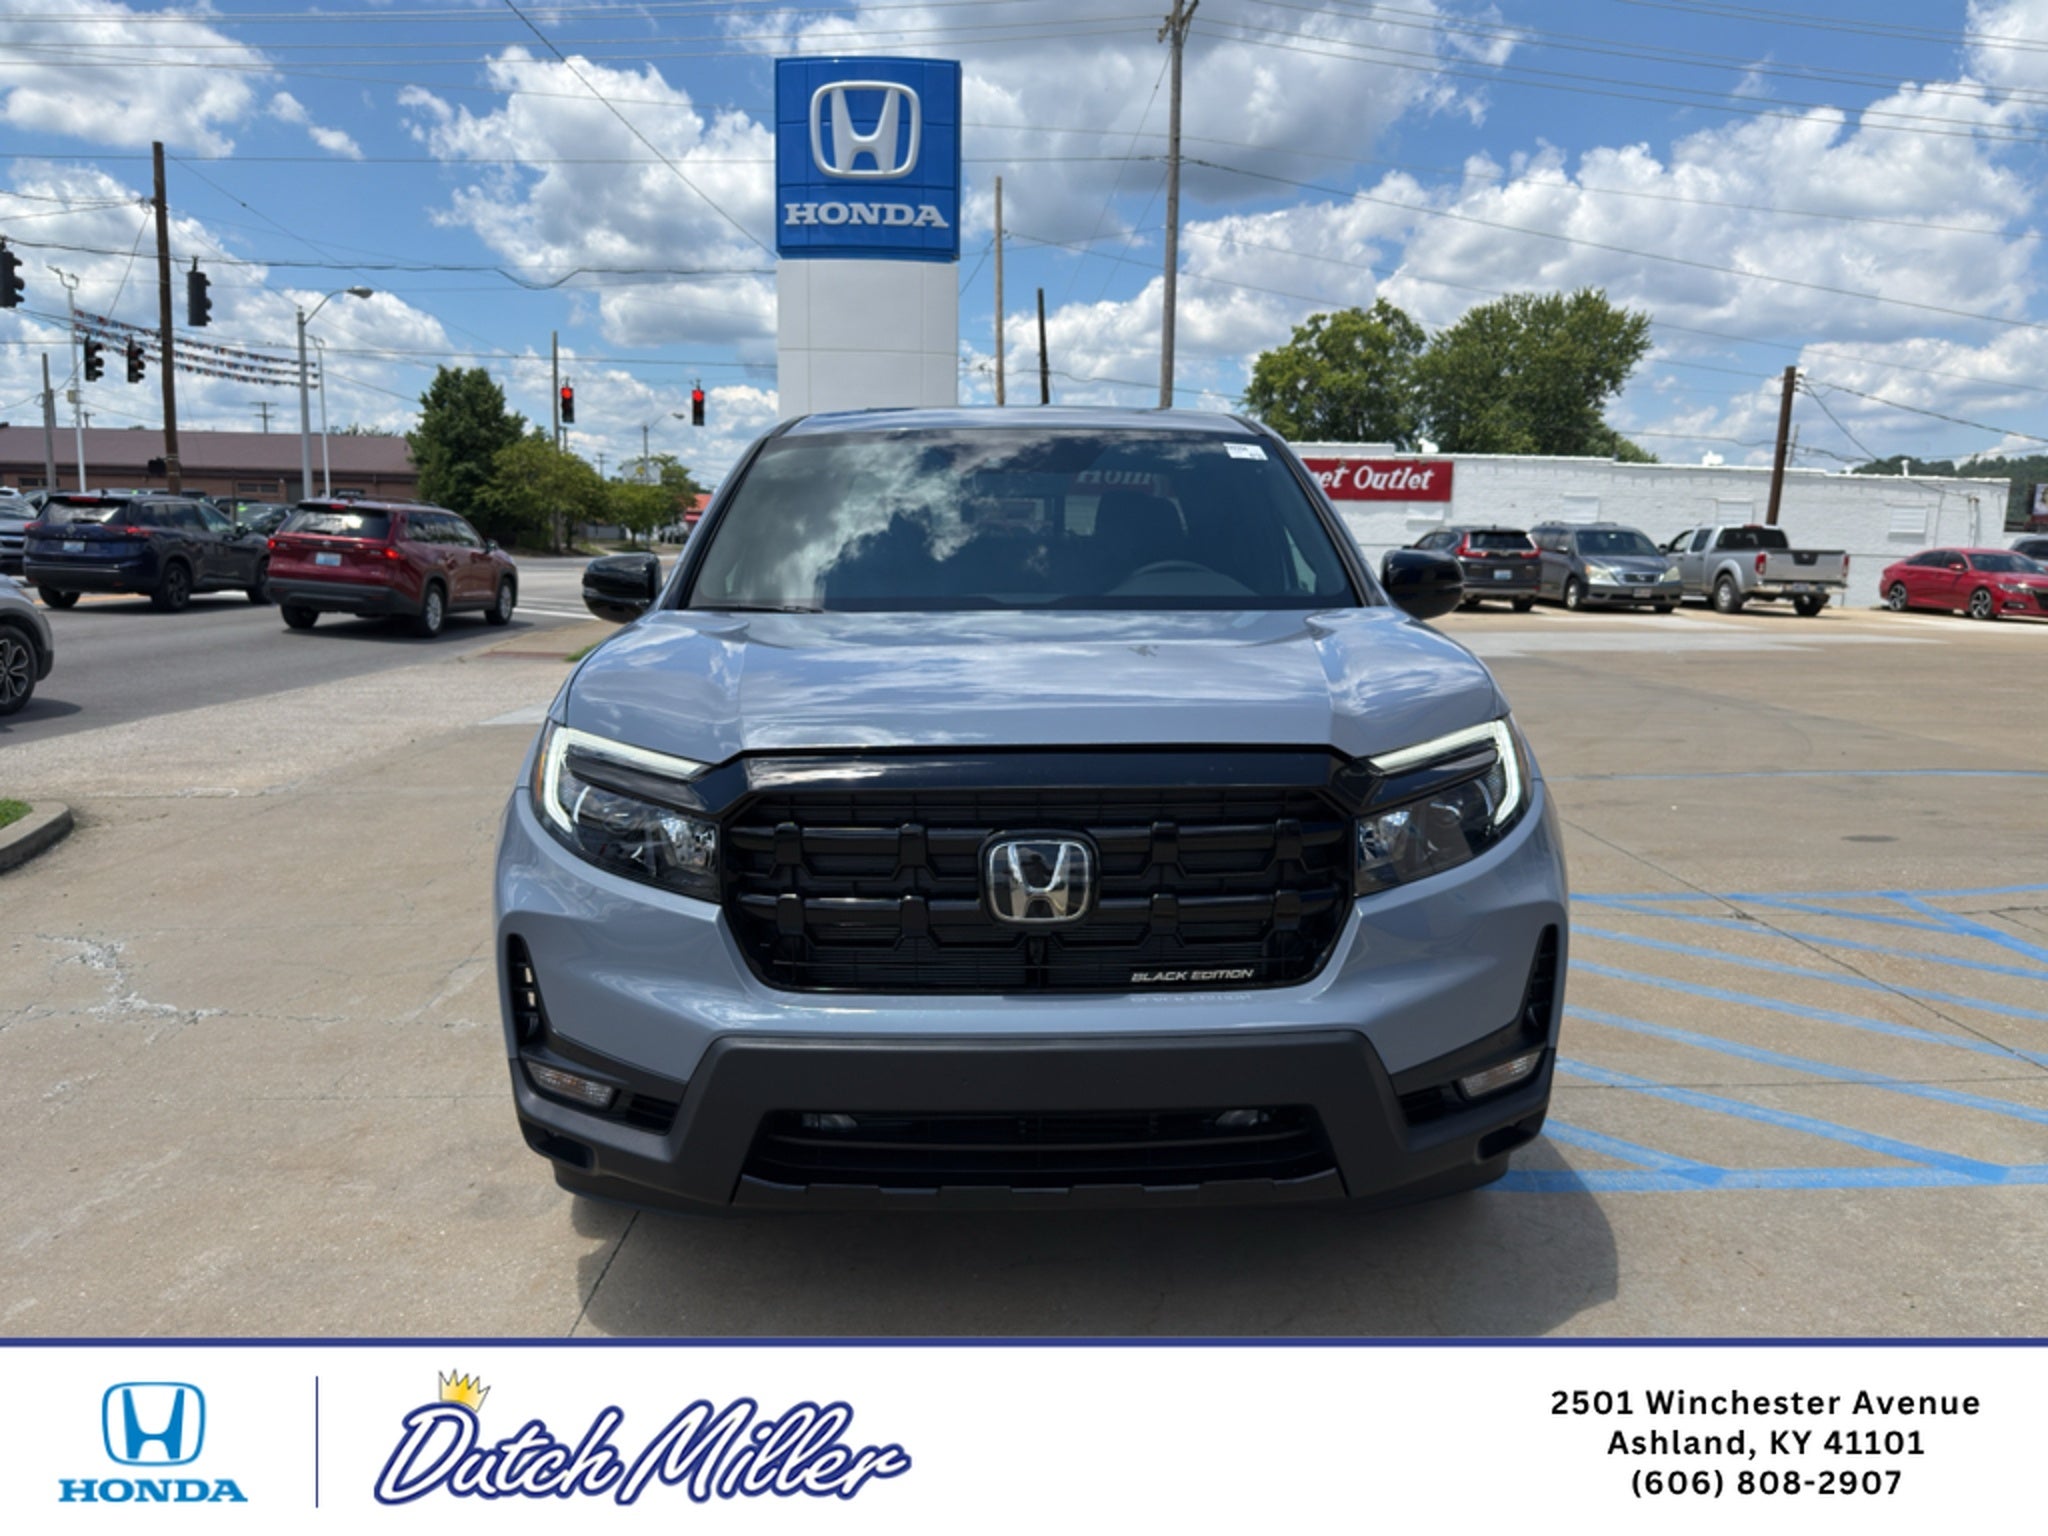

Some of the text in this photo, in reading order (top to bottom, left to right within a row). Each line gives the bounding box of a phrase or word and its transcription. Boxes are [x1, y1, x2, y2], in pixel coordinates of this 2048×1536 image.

[784, 202, 950, 229] HONDA
[1353, 465, 1435, 491] Outlet
[1131, 968, 1255, 983] BLACK EDITION
